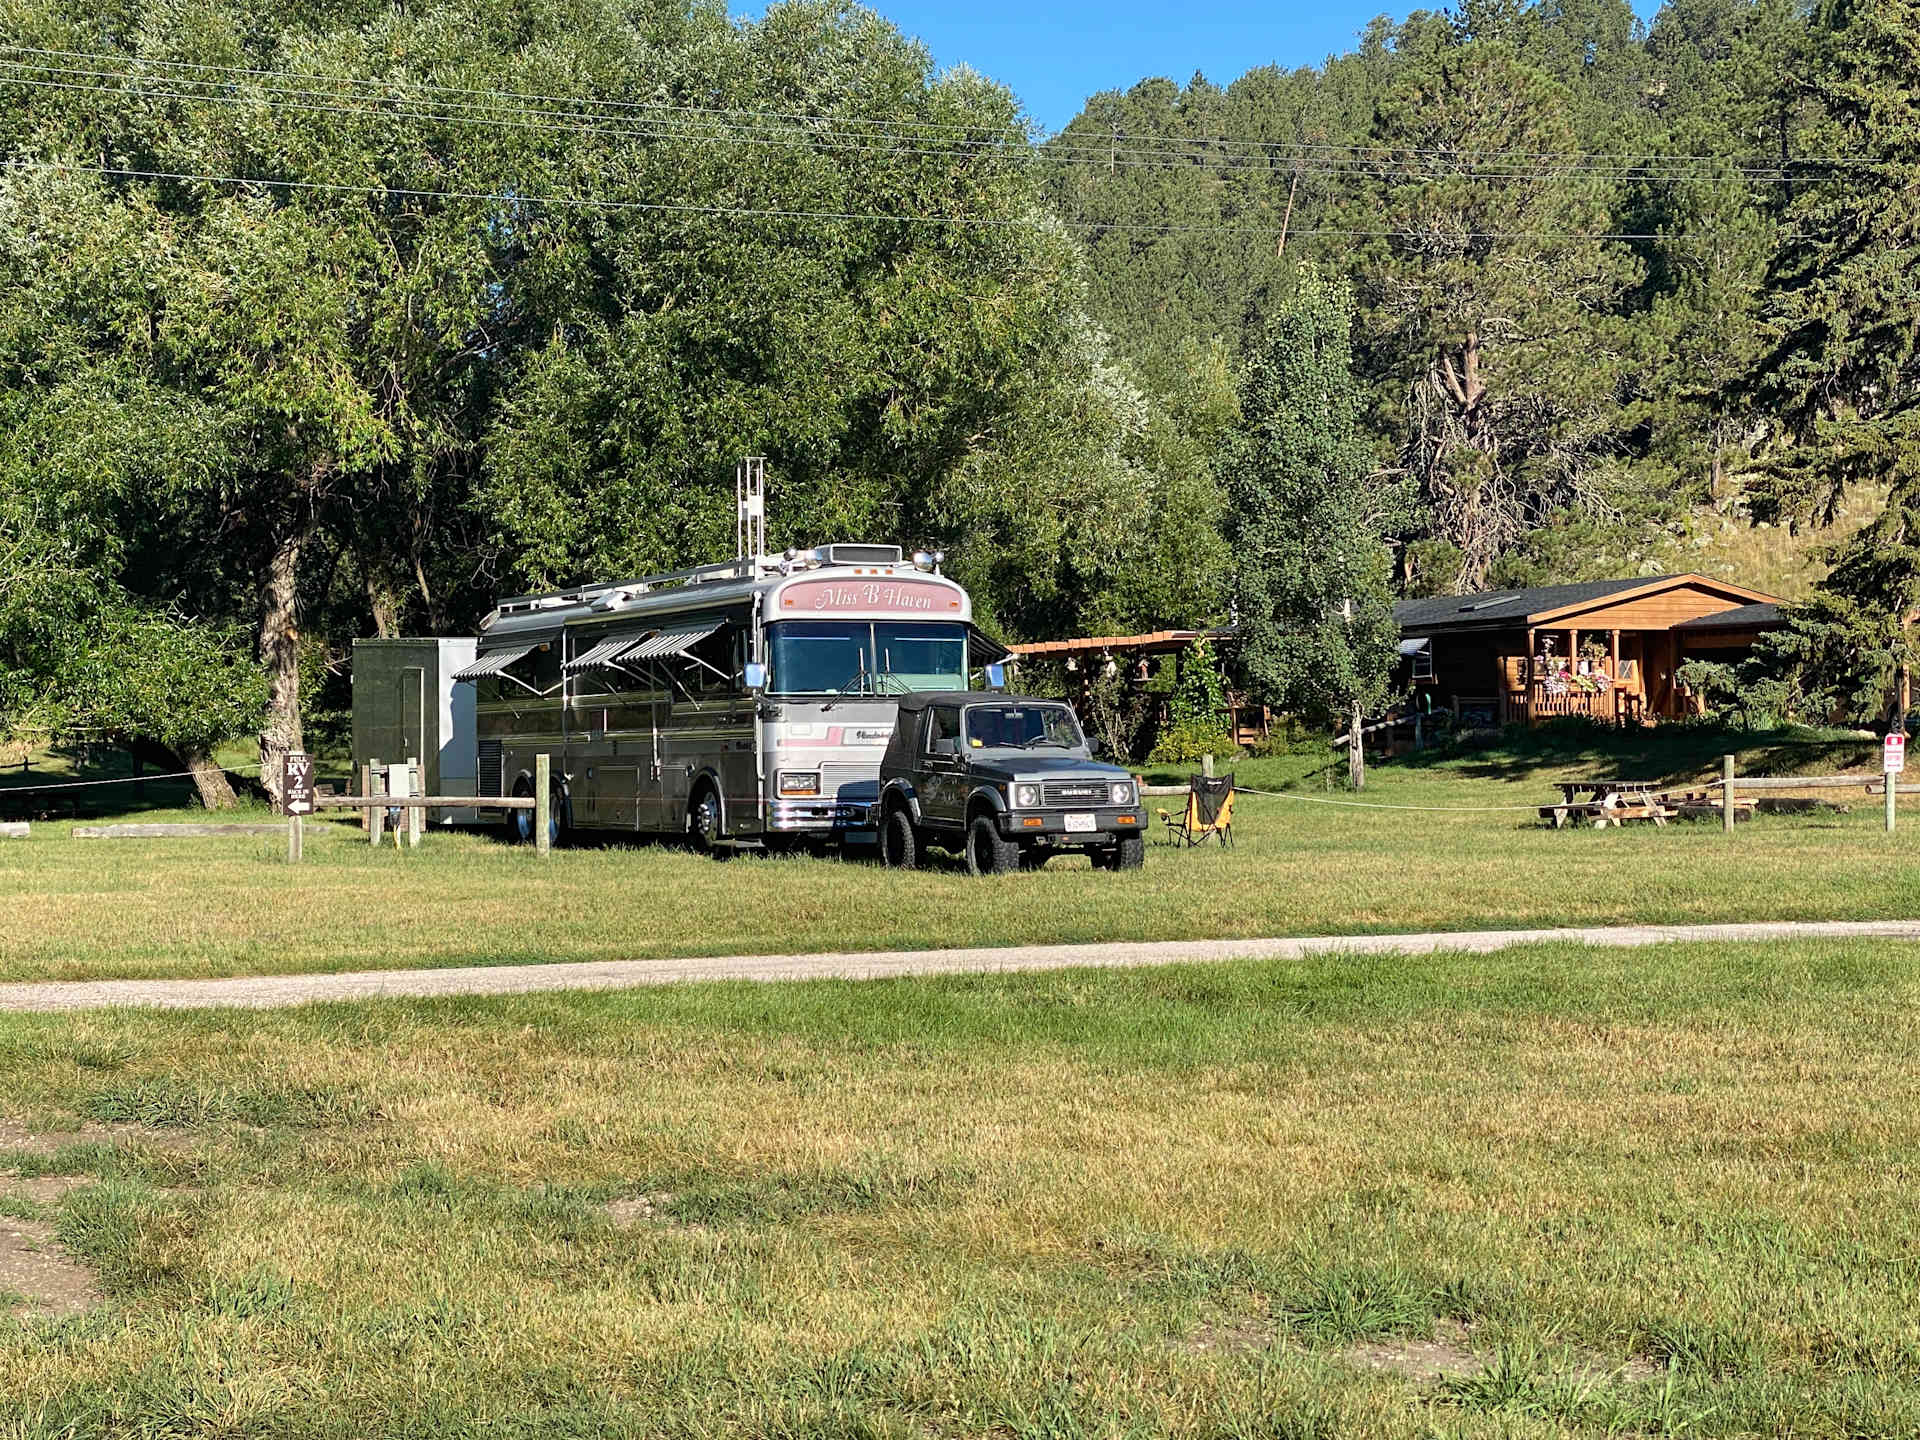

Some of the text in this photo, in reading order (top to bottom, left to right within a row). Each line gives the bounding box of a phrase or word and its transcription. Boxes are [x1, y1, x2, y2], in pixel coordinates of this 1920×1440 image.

[815, 584, 931, 609] Miss B Haven
[287, 762, 310, 776] RV
[294, 776, 304, 789] 2
